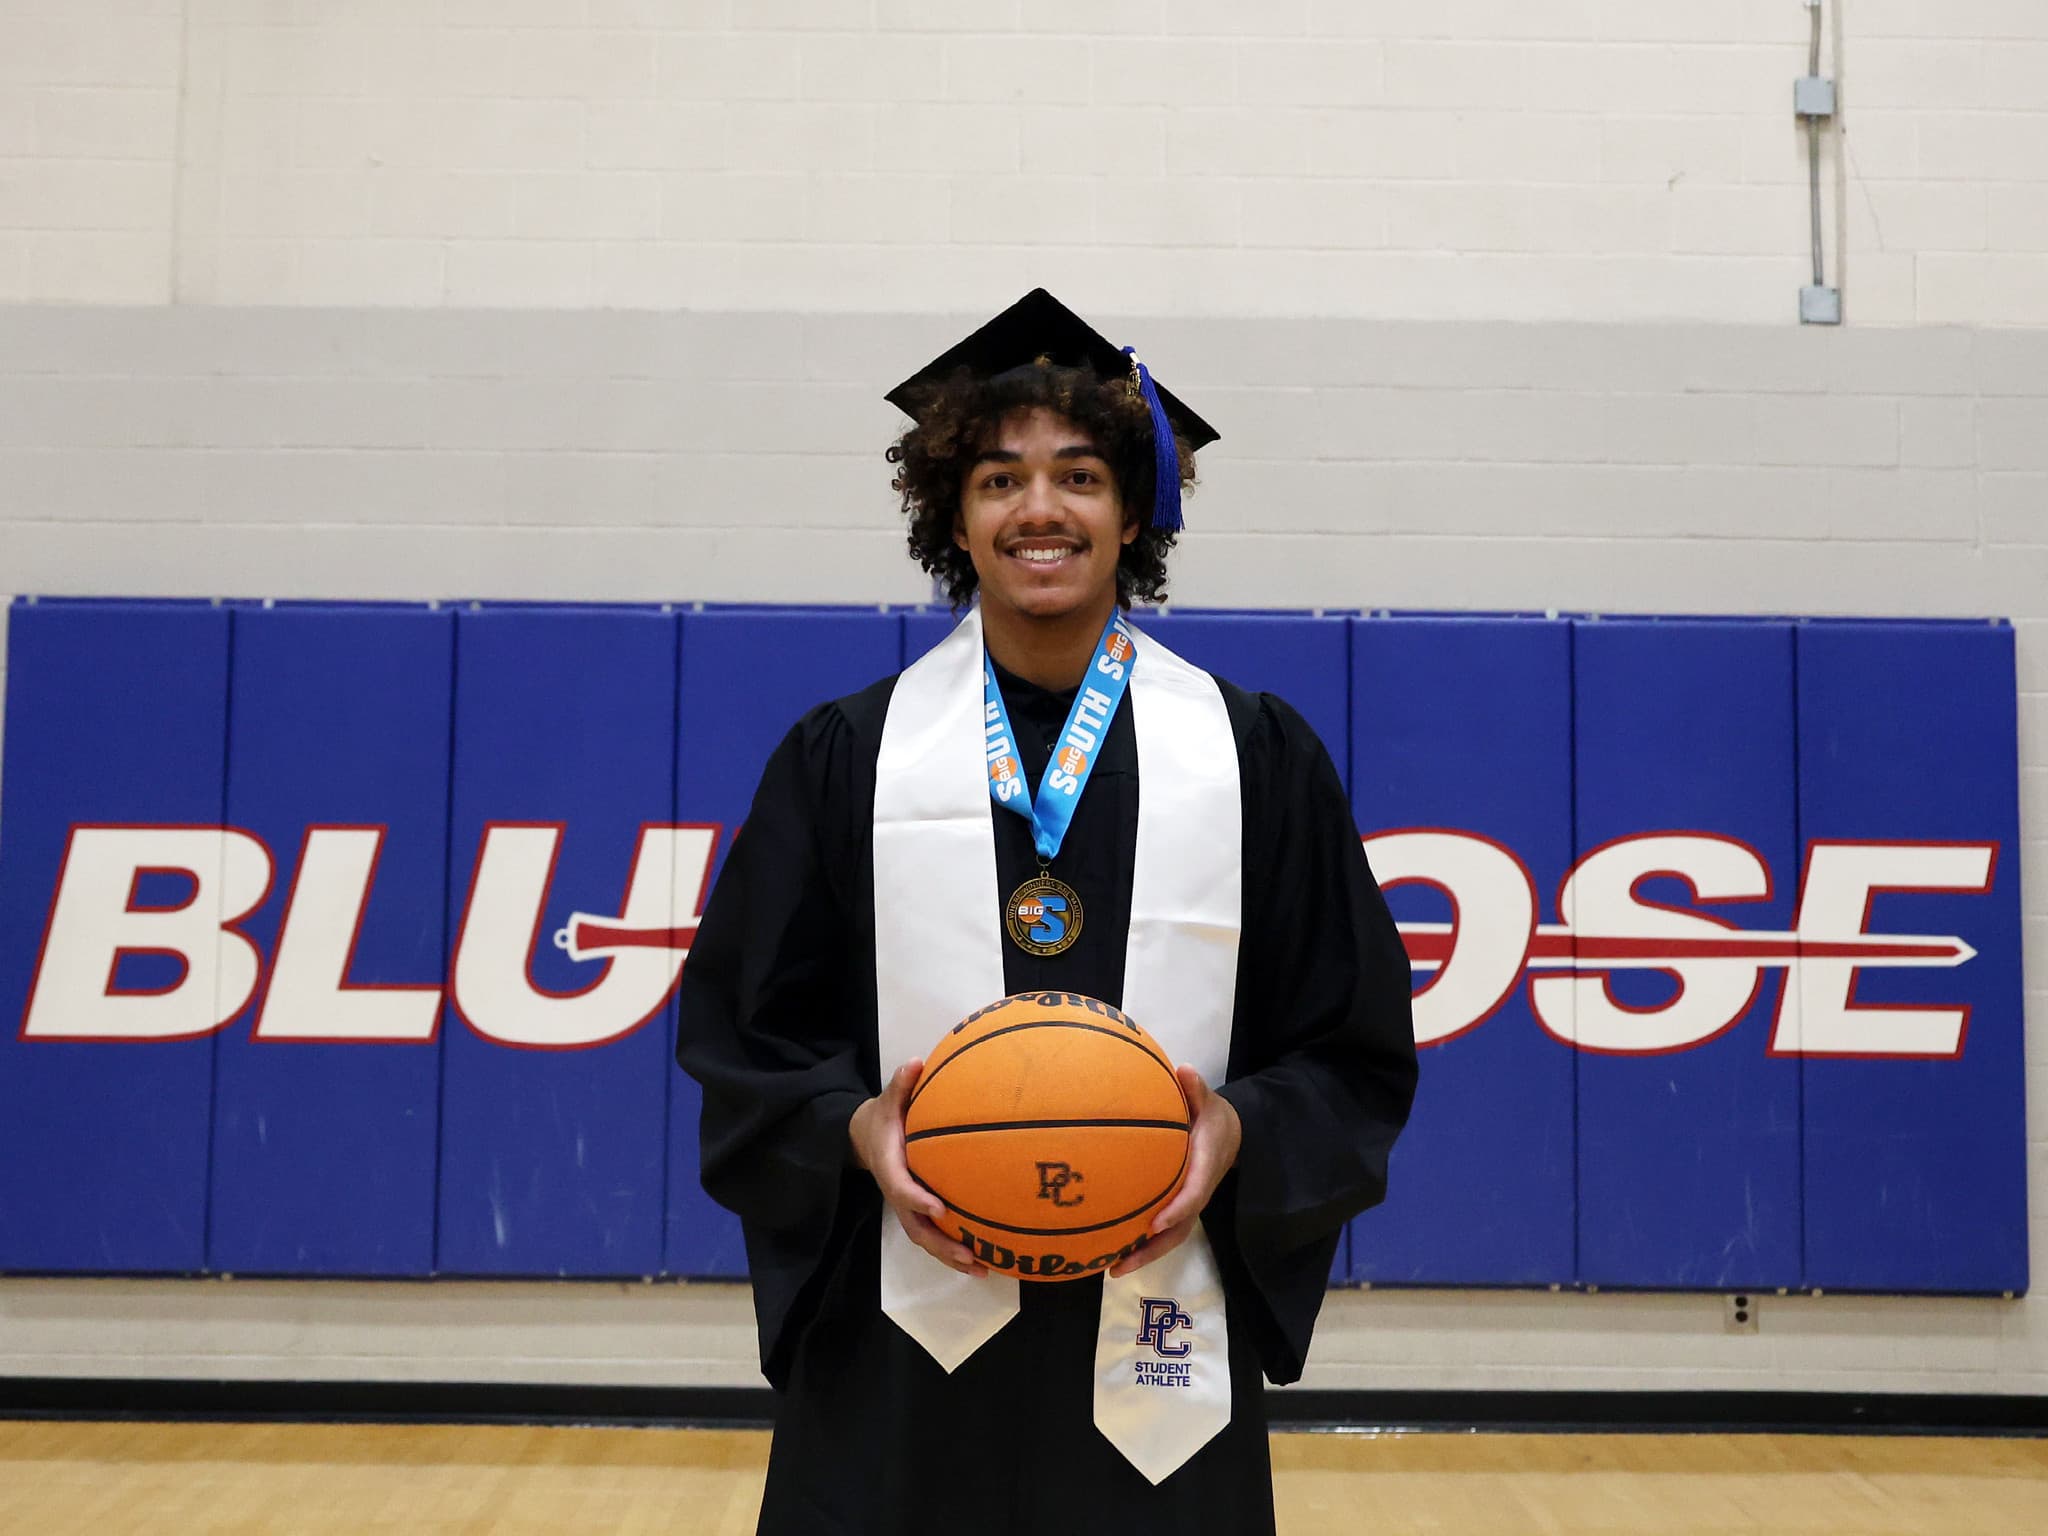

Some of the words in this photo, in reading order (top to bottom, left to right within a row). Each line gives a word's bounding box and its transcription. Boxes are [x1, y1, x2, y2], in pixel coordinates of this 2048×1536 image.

[1062, 747, 1082, 775] BIG
[1018, 905, 1044, 915] BIG
[18, 822, 742, 1051] BLU
[1361, 827, 2000, 1059] OSE
[1136, 1297, 1193, 1358] PC
[1134, 1361, 1192, 1375] STUDENT
[1135, 1374, 1192, 1388] ATHLETE
